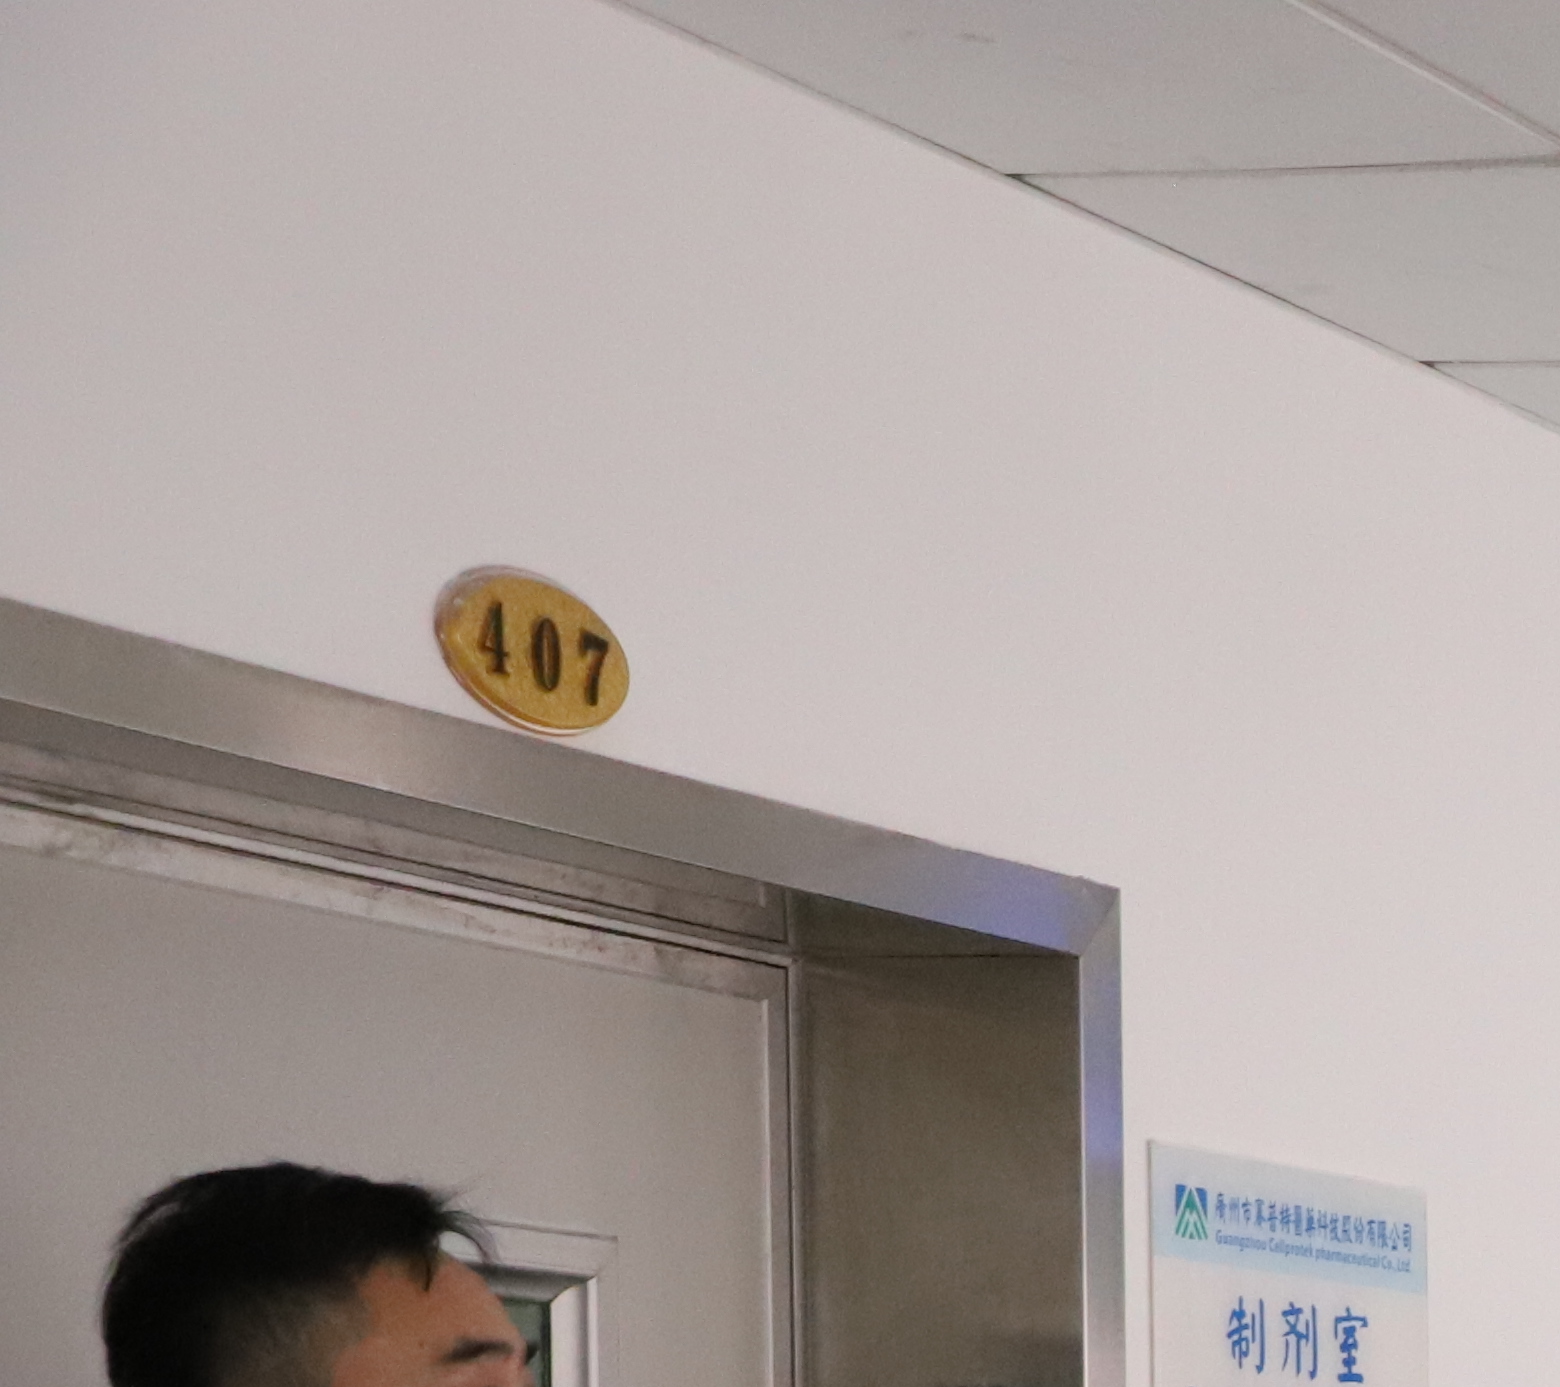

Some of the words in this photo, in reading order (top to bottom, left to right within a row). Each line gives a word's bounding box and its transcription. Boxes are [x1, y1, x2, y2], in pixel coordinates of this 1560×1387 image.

[477, 600, 609, 707] 407
[1226, 1296, 1368, 1384] 制剂室
